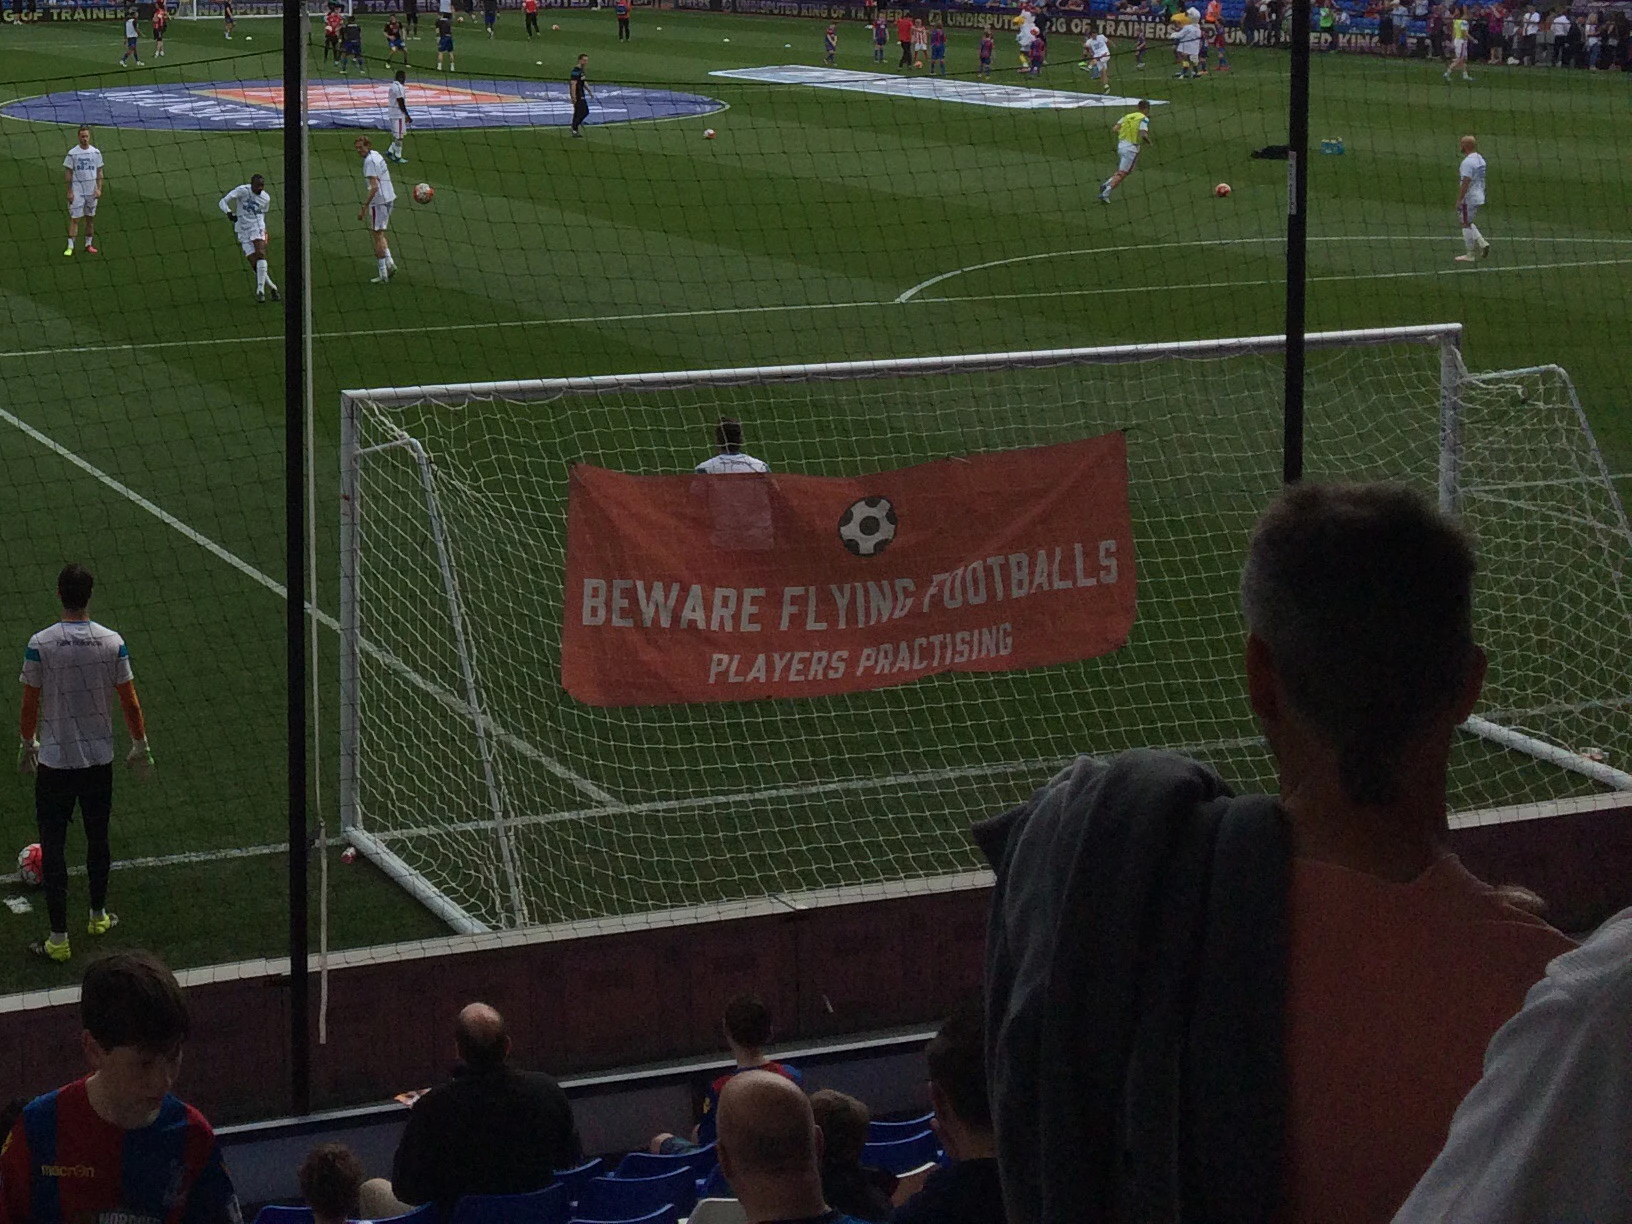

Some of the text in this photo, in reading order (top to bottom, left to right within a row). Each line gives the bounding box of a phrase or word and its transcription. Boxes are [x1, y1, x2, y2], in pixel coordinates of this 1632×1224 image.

[1072, 18, 1091, 33] OF
[581, 539, 1120, 633] BEWARE FLYING FOOTBALLS
[709, 622, 1014, 684] PLAYERS PRACTISING
